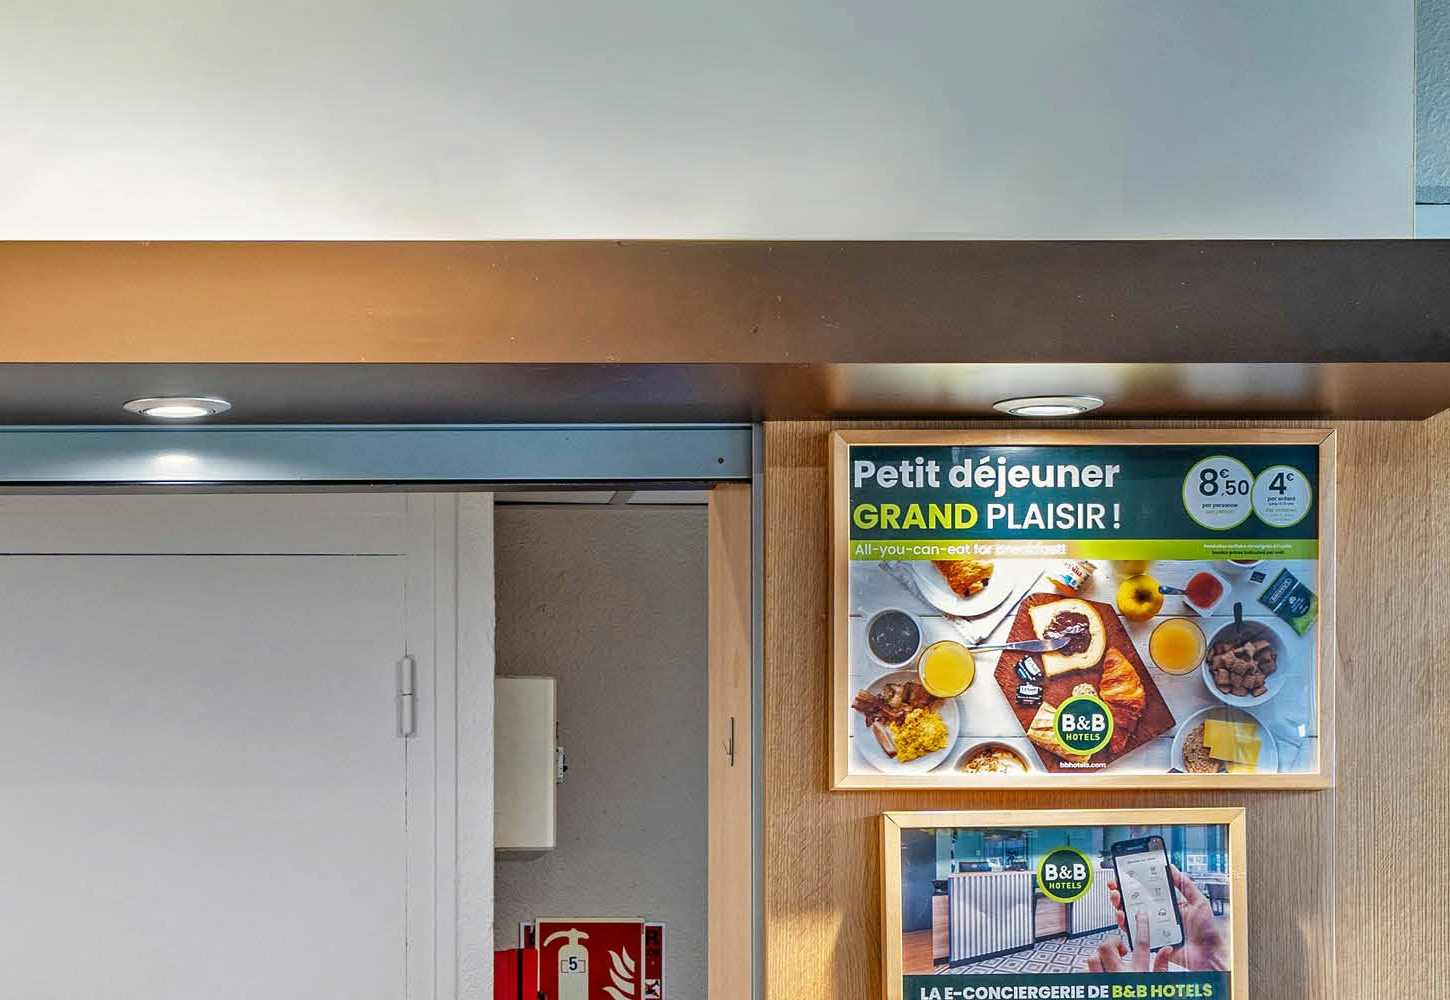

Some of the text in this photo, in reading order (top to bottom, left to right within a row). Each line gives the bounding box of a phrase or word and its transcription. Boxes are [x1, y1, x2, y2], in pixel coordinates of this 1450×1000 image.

[853, 454, 1120, 498] Petit déjeuner
[852, 502, 1121, 530] GRAND PLAISIR !
[854, 543, 971, 558] All-you-can-eat
[1061, 713, 1106, 732] B&B
[1066, 733, 1101, 741] HOTELS
[1059, 761, 1107, 769] bbhotels.com
[1044, 863, 1087, 881] B&B
[568, 956, 578, 971] 5
[920, 982, 1212, 1000] LA E-CONCIERGERIE DE B&B HOTELS
